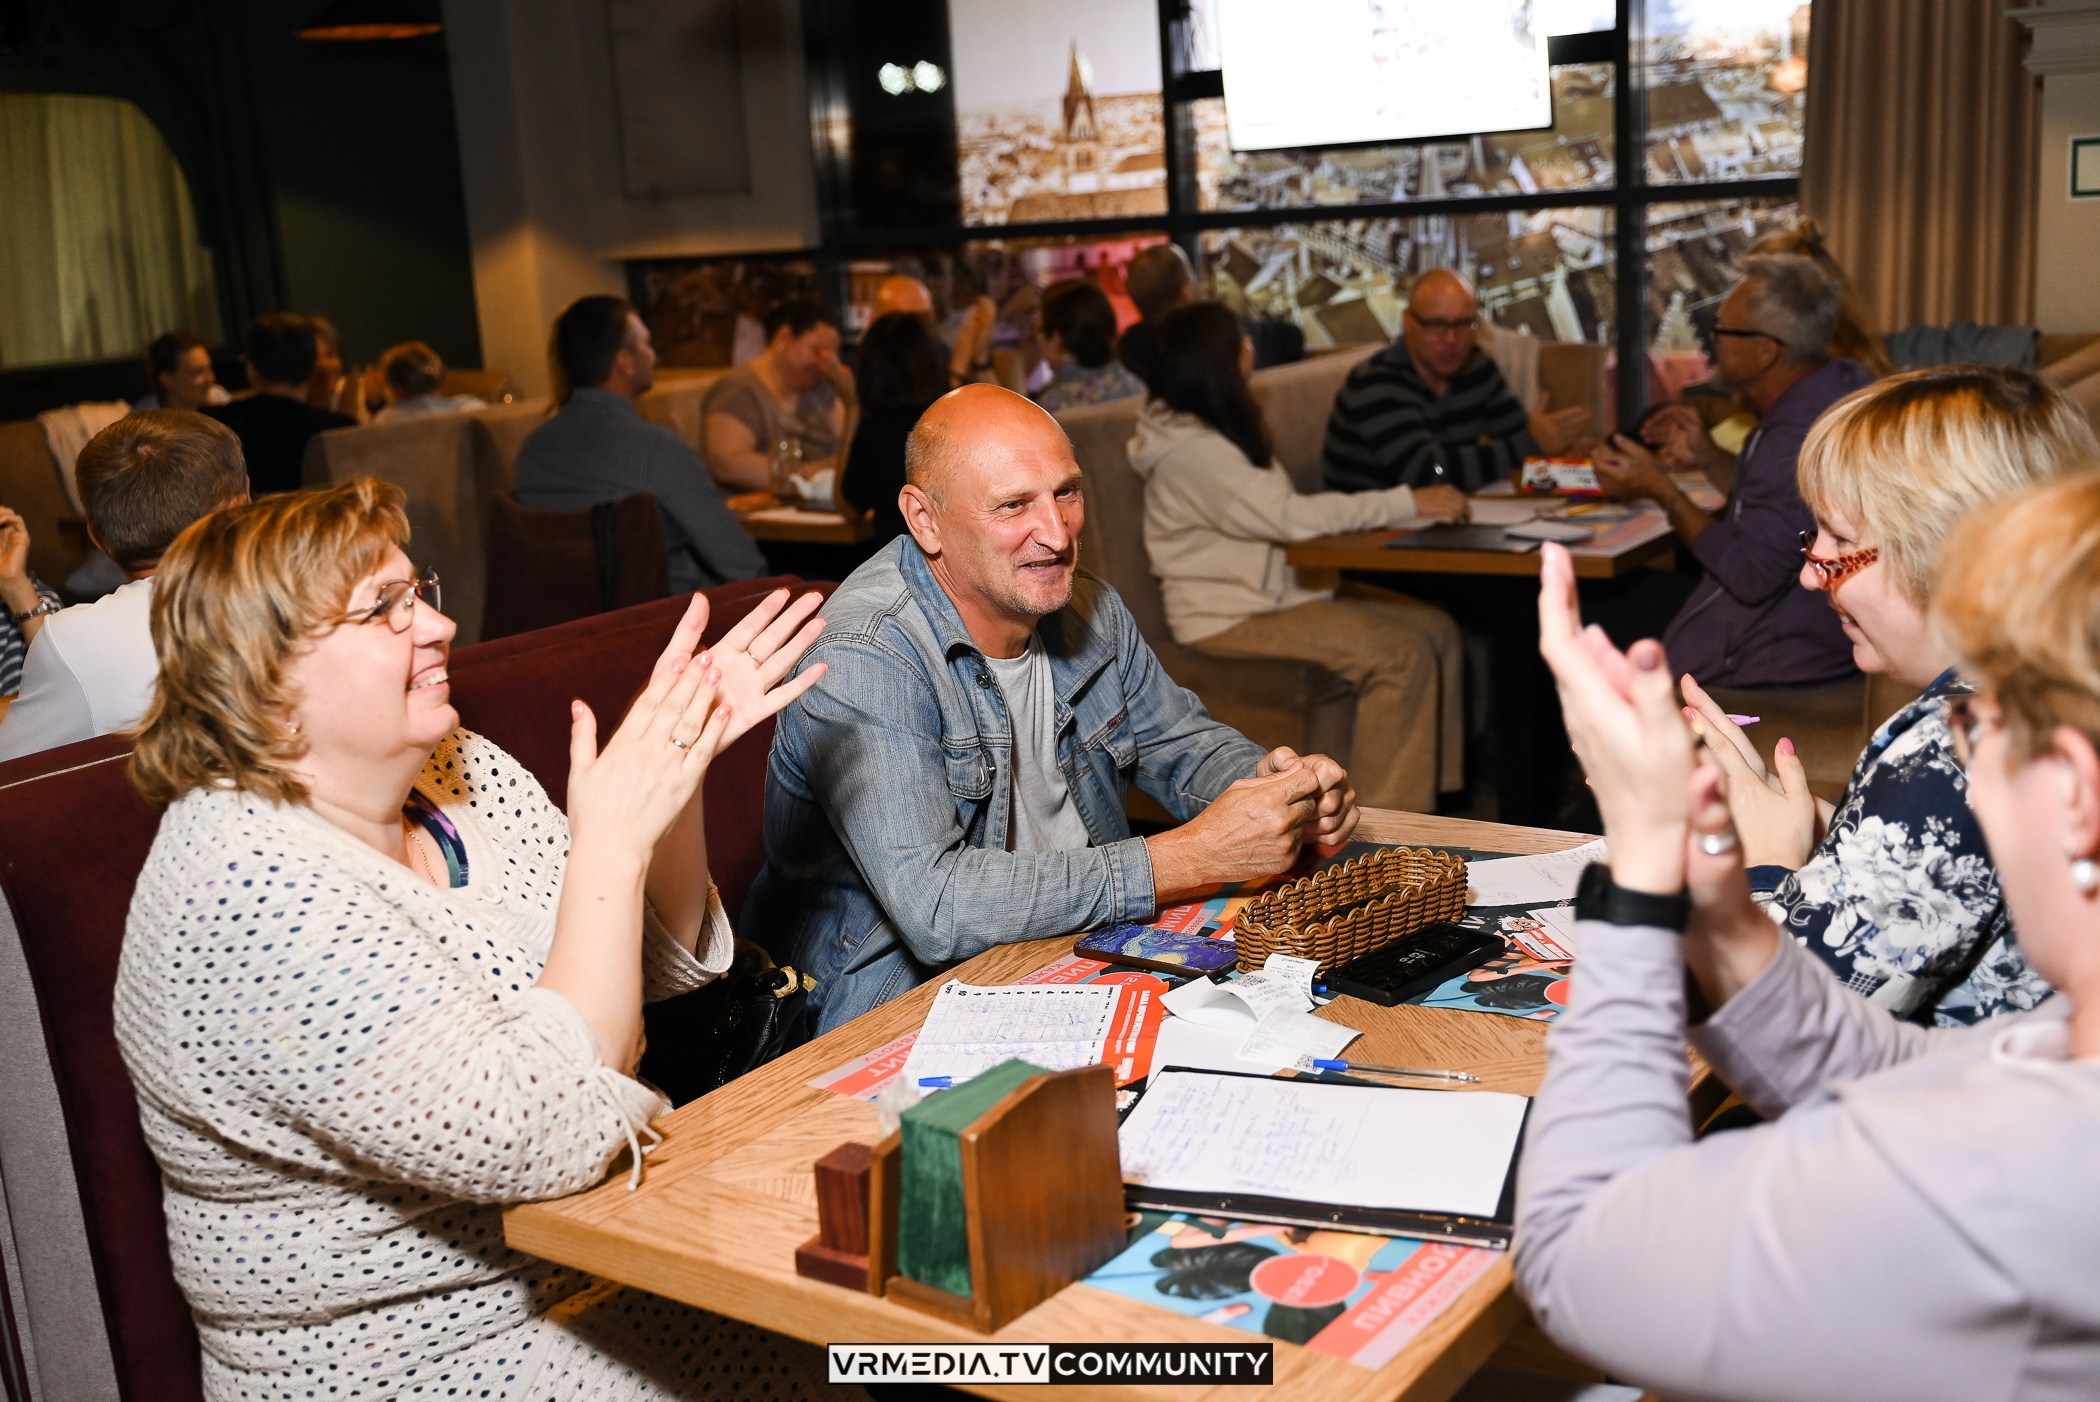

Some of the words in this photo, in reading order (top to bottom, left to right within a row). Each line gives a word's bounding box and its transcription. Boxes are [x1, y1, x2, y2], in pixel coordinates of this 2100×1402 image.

[1018, 963, 1065, 985] КАЖДУ
[1043, 961, 1100, 985] ПИВ
[864, 1032, 919, 1063] УББОТУ
